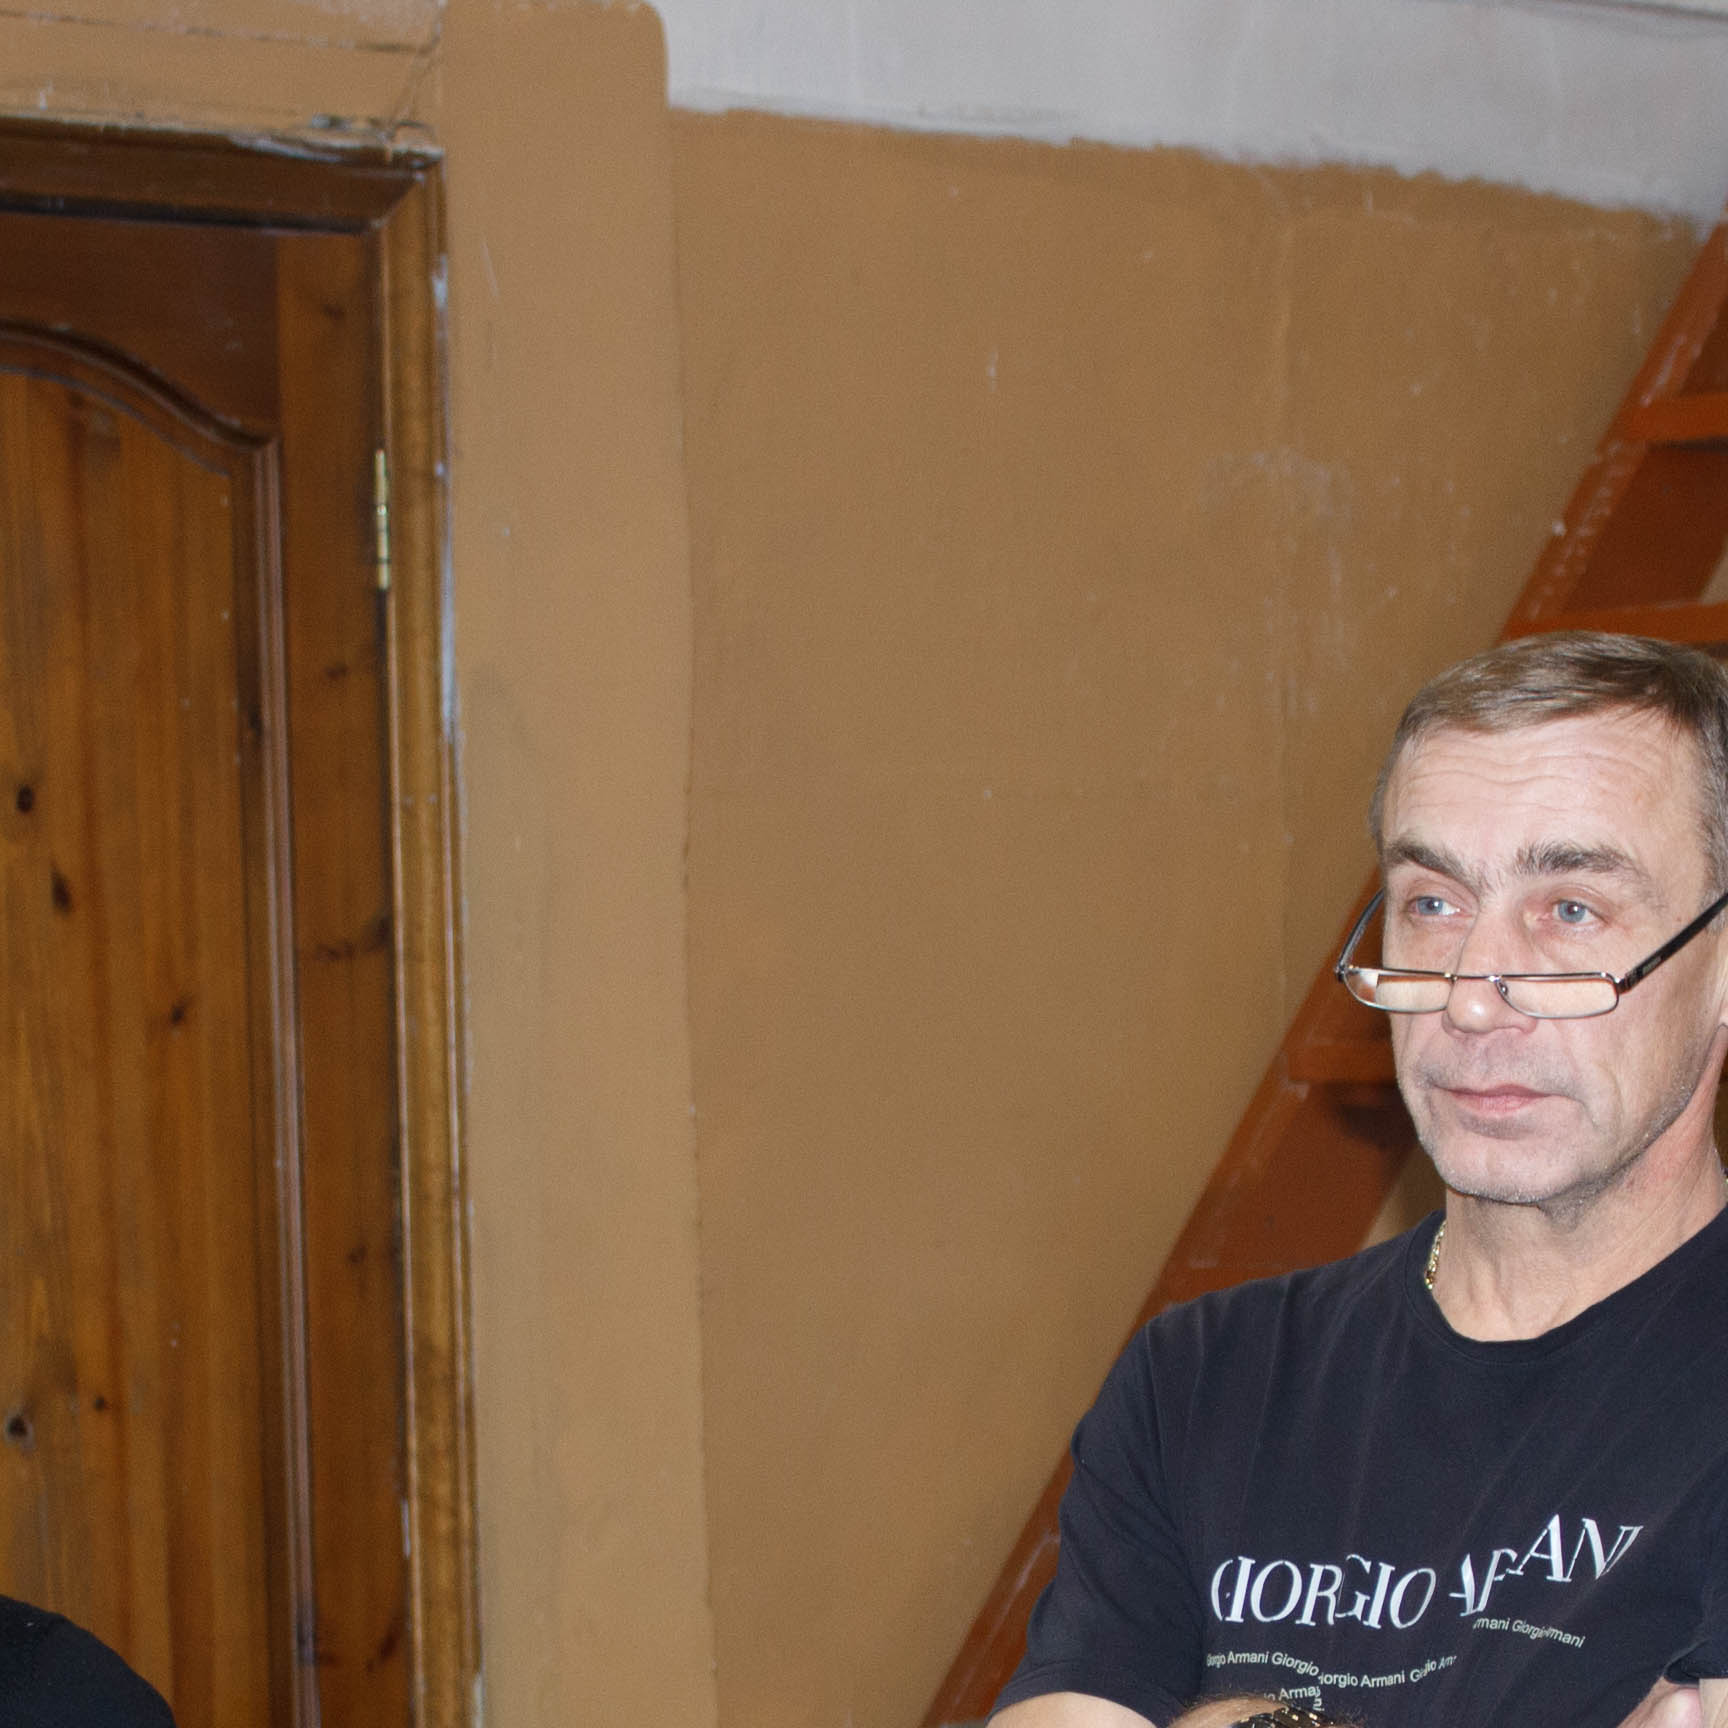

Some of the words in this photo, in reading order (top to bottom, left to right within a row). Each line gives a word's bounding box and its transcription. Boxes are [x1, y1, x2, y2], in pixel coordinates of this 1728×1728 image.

[1227, 1651, 1270, 1664] Armani
[1271, 1652, 1319, 1676] Giorgio
[1318, 1672, 1359, 1688] iorgio
[1360, 1670, 1405, 1688] Armani
